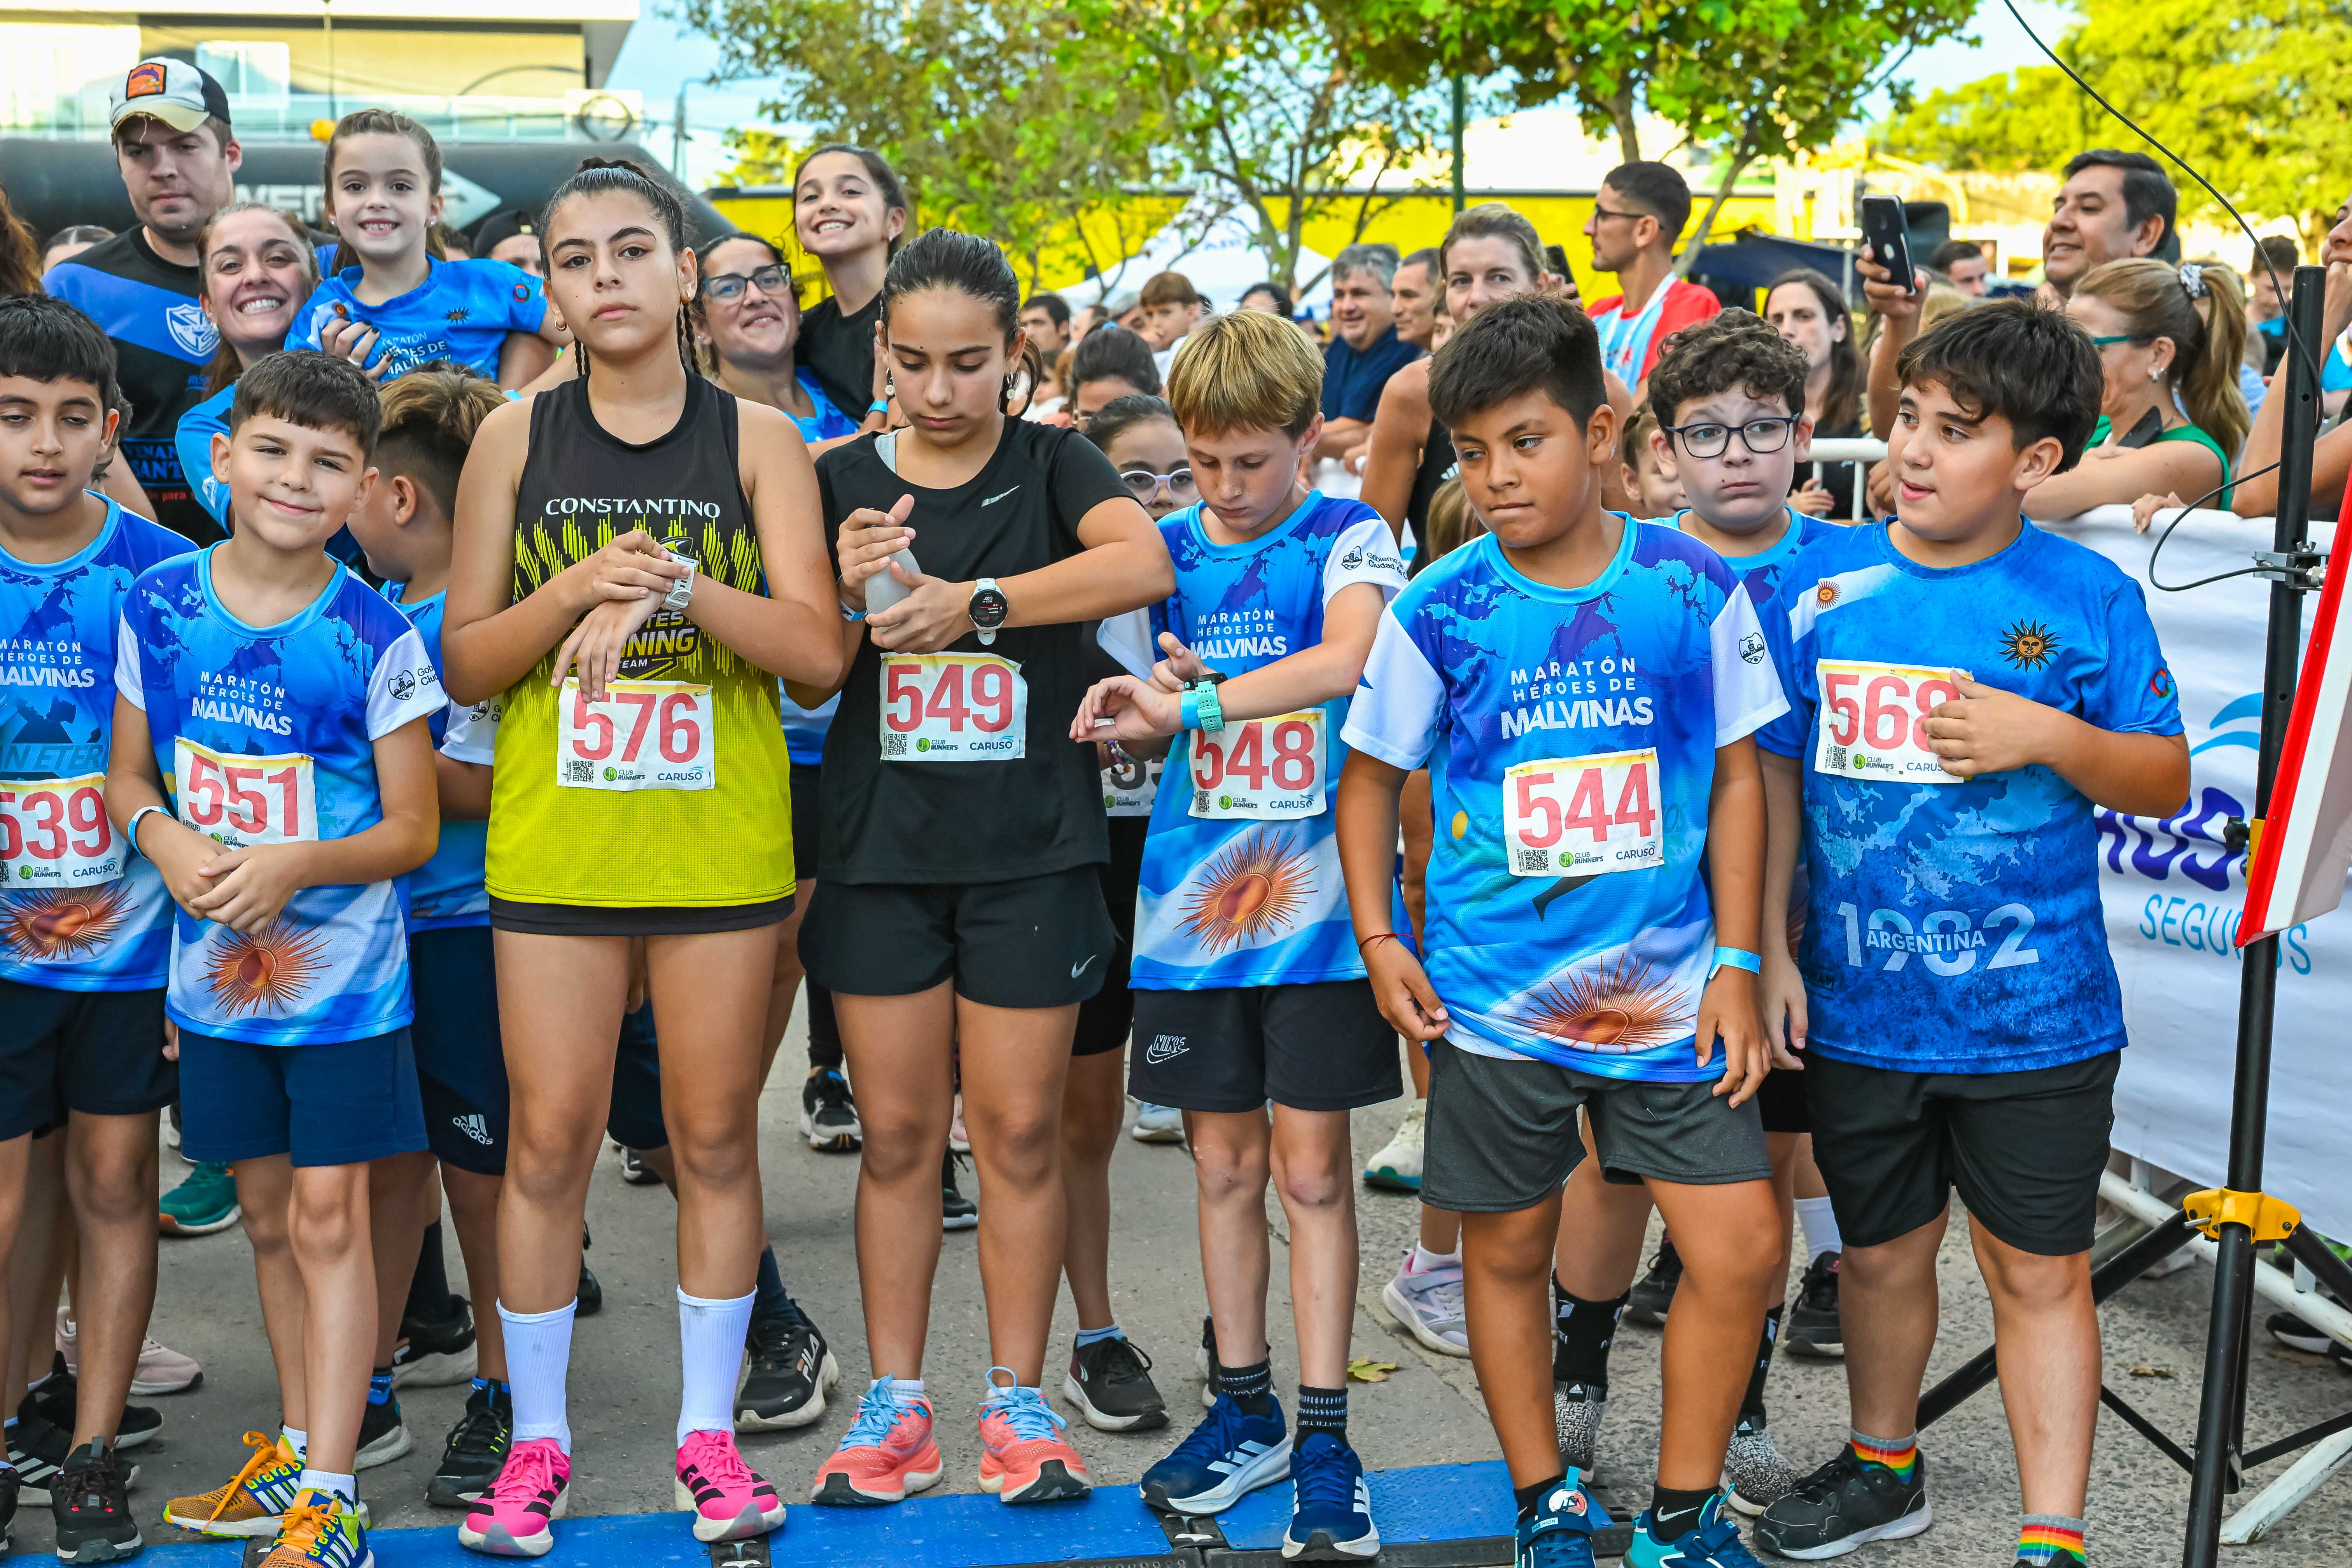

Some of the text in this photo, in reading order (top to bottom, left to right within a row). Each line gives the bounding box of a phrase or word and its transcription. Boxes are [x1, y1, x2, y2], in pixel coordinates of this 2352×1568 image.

[428, 341, 447, 353] DE
[545, 498, 720, 518] CONSTANTINO
[1367, 553, 1398, 564] Gobierno
[1368, 560, 1395, 570] Ciudad
[1198, 607, 1274, 625] MARATÓN
[1197, 623, 1274, 637] HÉROES DE
[0, 639, 81, 653] MARATÓN
[621, 628, 695, 657] NING
[1190, 636, 1287, 660] MALVINAS
[63, 656, 82, 665] DE
[1511, 656, 1636, 685] MARATÓN
[201, 671, 285, 699] MARATÓN
[201, 684, 282, 710] HÉROES DE
[1513, 677, 1636, 702] HÉROES DE
[887, 664, 1013, 733] 549
[1501, 696, 1654, 739] MALVINAS
[1825, 673, 1960, 753] 568
[573, 690, 700, 763] 576
[970, 740, 1013, 751] CARUSO
[1195, 720, 1315, 791] 548
[658, 772, 703, 782] CARUSO
[1866, 761, 1894, 770] RUNNER'S
[188, 752, 298, 836] 551
[1270, 800, 1312, 809] CARUSO
[1517, 763, 1656, 848] 544
[0, 787, 111, 860] 539
[1575, 856, 1603, 864] RUNNER'S
[1616, 847, 1655, 861] CARUSO
[73, 863, 116, 878] CARUSO
[1838, 901, 2040, 976] 1982
[1866, 930, 1986, 953] ARGENTINA
[2139, 894, 2312, 975] SEGUS
[1153, 1034, 1186, 1052] NIKE
[453, 1117, 493, 1144] adidas
[797, 1334, 819, 1383] FILA
